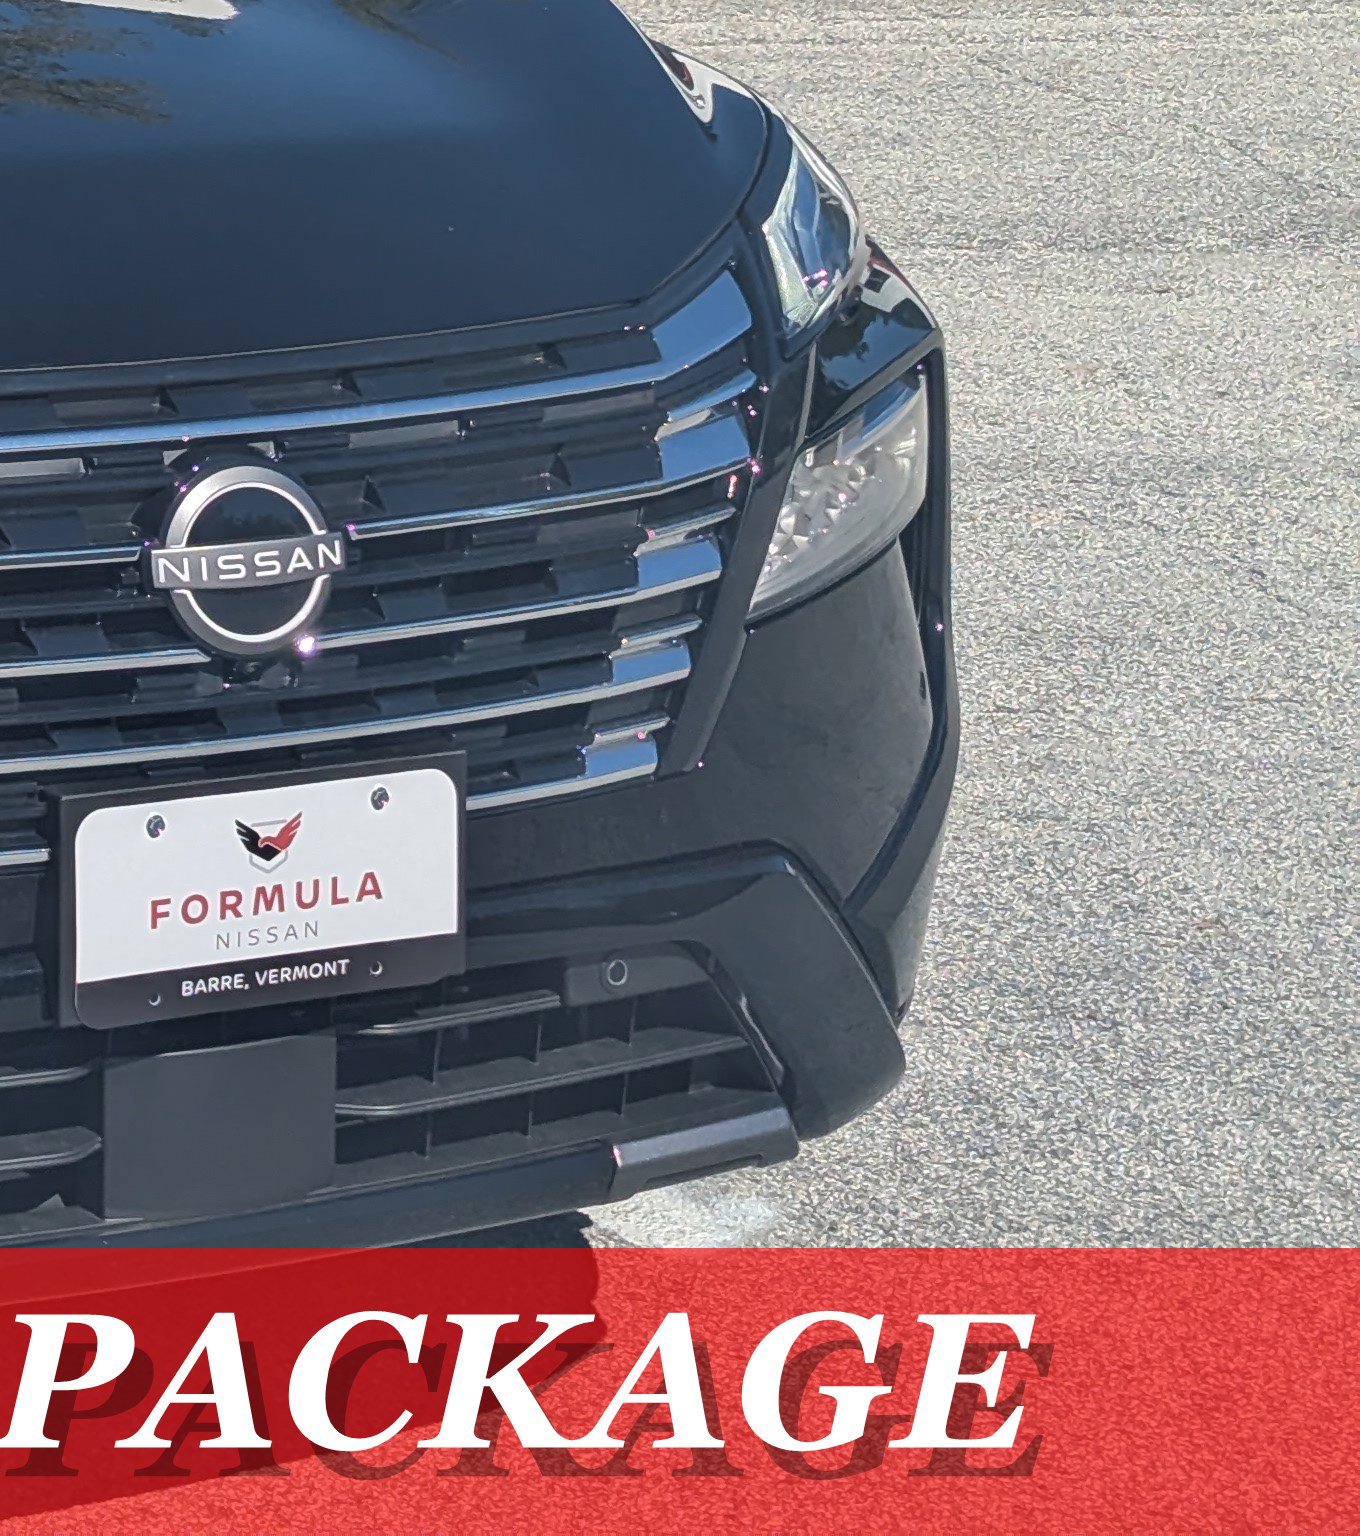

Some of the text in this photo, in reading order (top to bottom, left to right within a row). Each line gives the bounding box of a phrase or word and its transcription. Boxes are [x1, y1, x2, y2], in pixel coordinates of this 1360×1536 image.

[157, 539, 342, 584] NISSAN
[149, 870, 385, 931] FORMULA
[215, 920, 319, 951] NISSAN
[180, 958, 351, 998] BARRE, VERMONT
